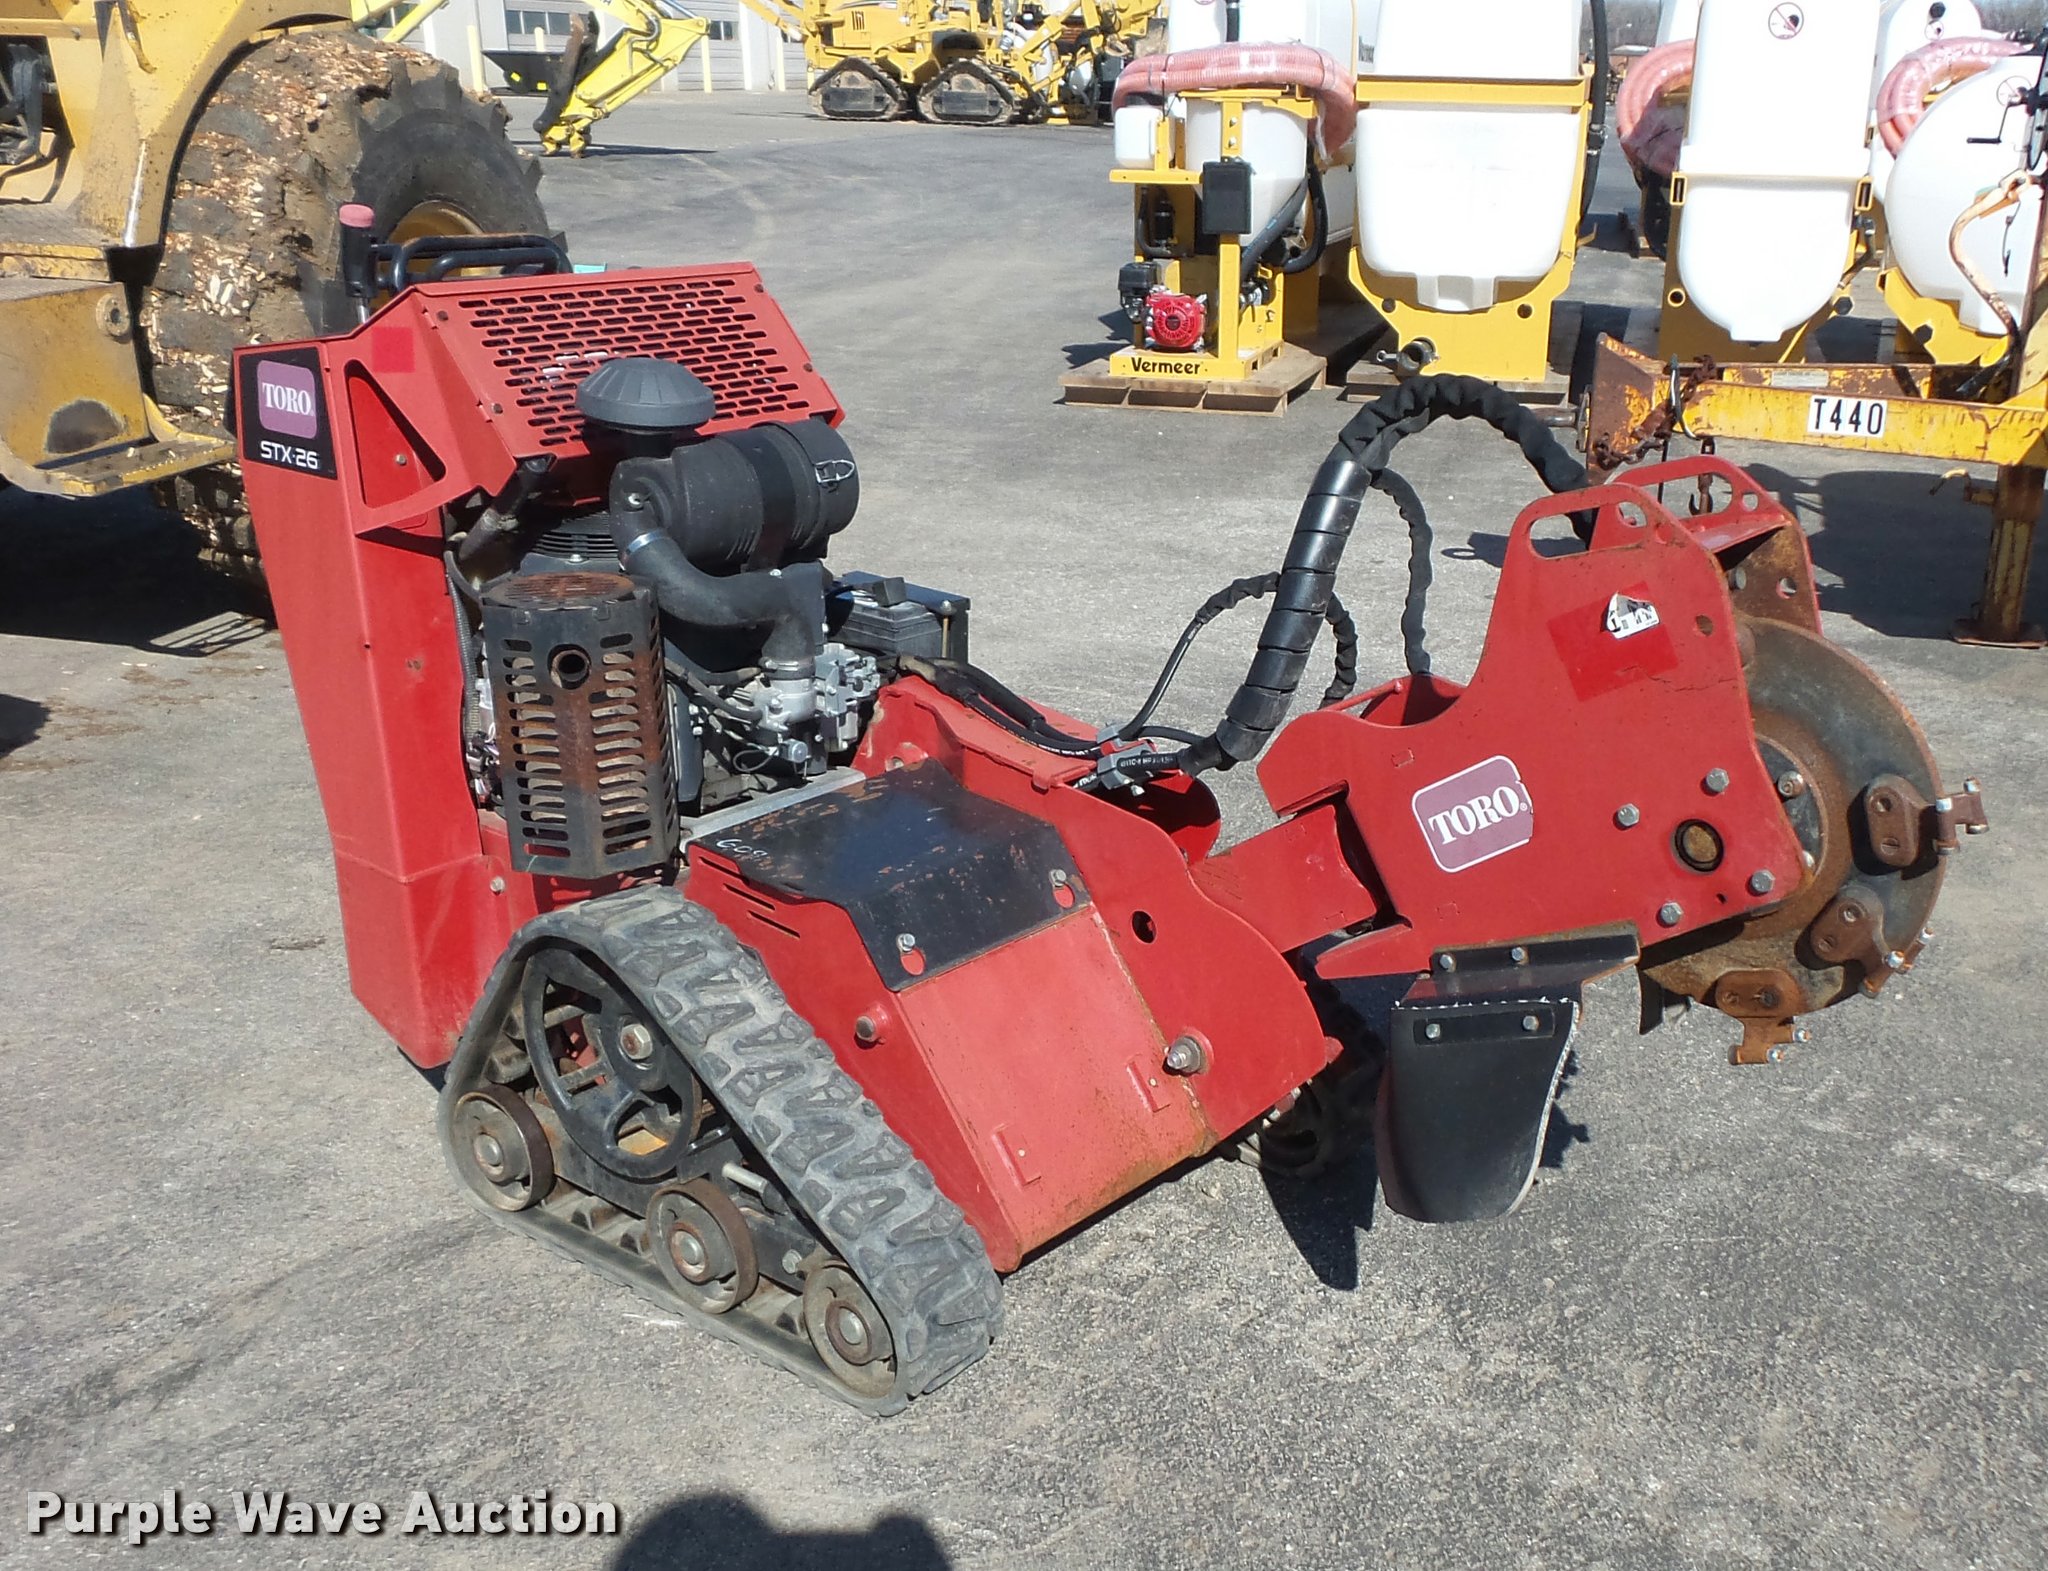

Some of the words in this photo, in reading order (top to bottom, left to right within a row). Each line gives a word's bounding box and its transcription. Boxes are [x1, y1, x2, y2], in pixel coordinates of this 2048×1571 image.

[1131, 357, 1200, 375] Vermeer
[262, 382, 312, 416] TORO
[1814, 398, 1883, 435] T440
[1428, 786, 1520, 845] TORO
